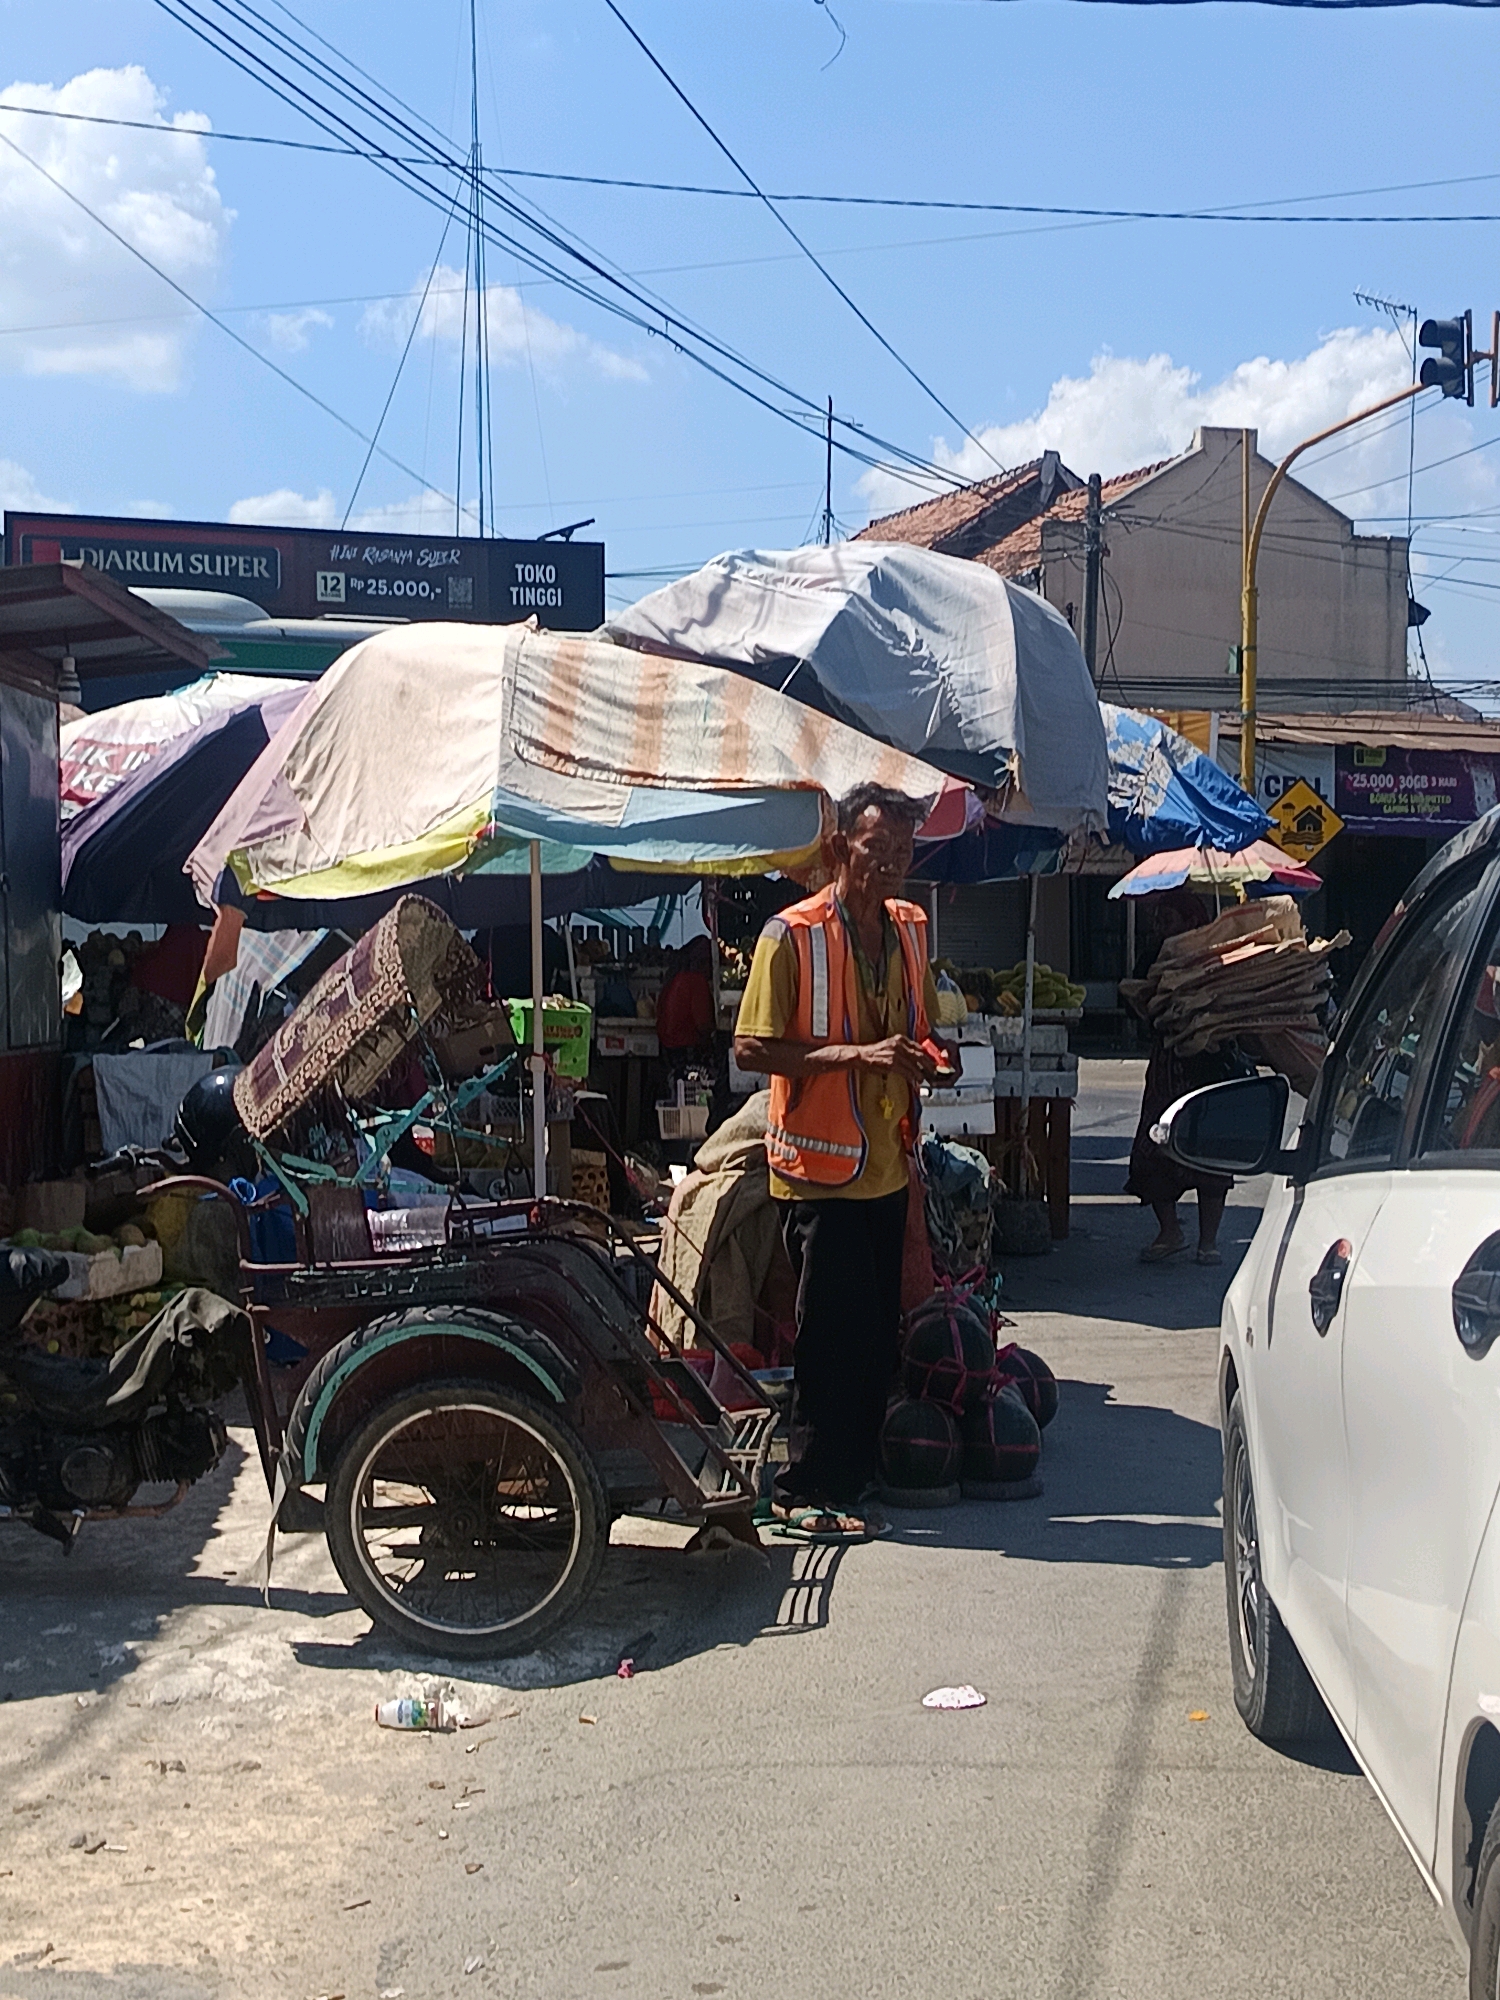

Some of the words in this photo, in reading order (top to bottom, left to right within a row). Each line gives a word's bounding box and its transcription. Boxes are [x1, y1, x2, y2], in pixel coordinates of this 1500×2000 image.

[81, 547, 183, 574] DJARUM
[189, 553, 270, 579] SUPER
[515, 564, 556, 584] TOKO
[321, 575, 341, 592] 12
[350, 577, 364, 590] Rp
[366, 578, 442, 600] 25.000,-
[510, 586, 562, 607] TINGGI
[1264, 774, 1328, 799] CEL
